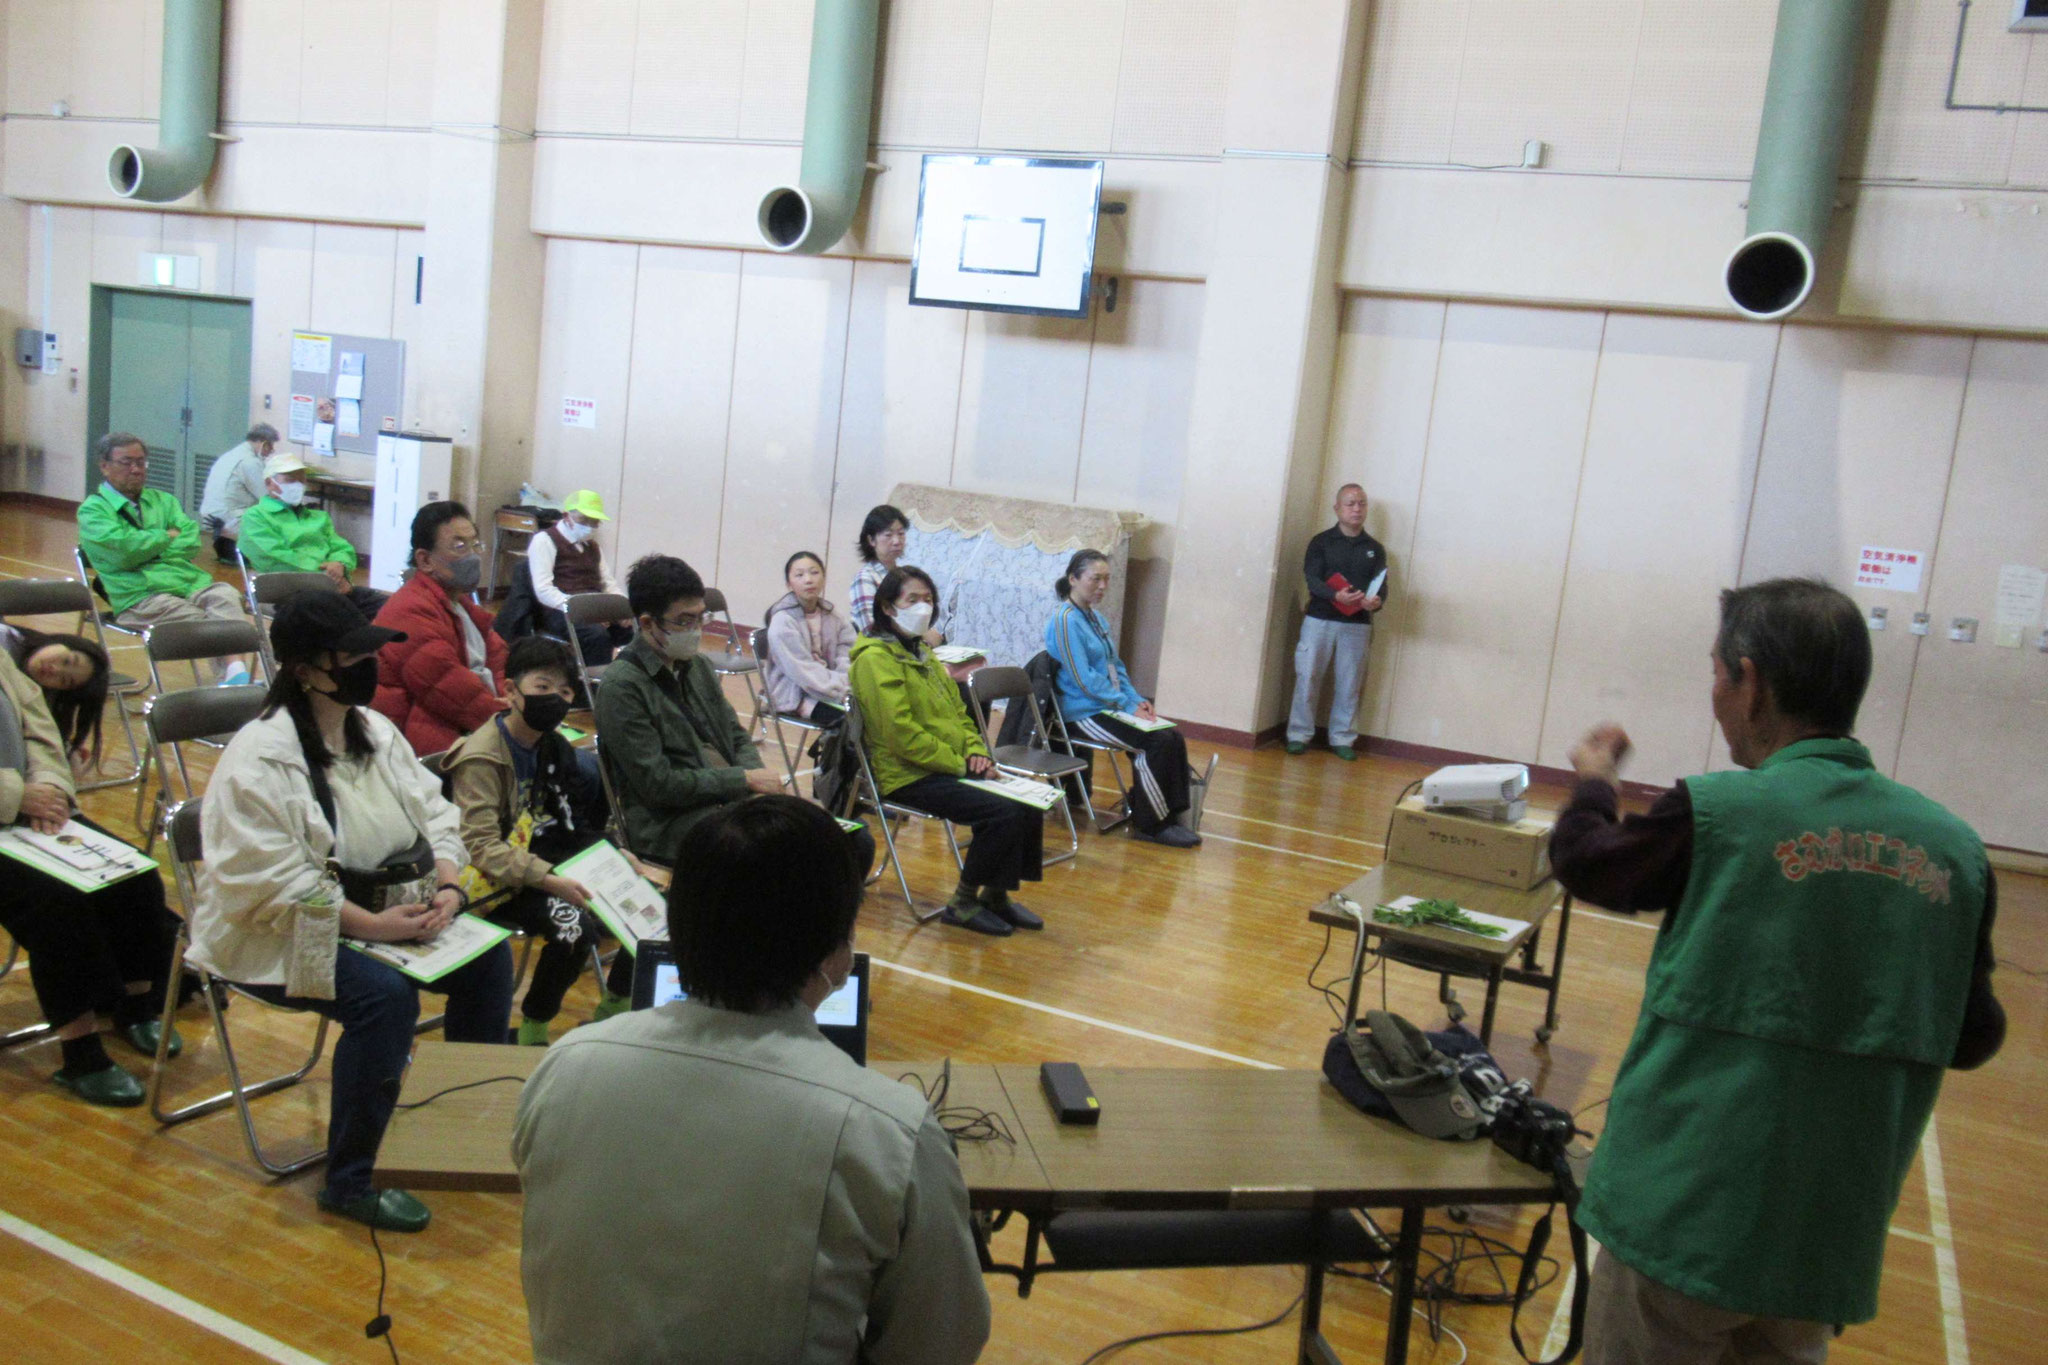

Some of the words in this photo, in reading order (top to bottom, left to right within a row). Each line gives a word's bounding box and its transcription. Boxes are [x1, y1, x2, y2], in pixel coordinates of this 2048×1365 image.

[1429, 830, 1486, 848] プロジェクター
